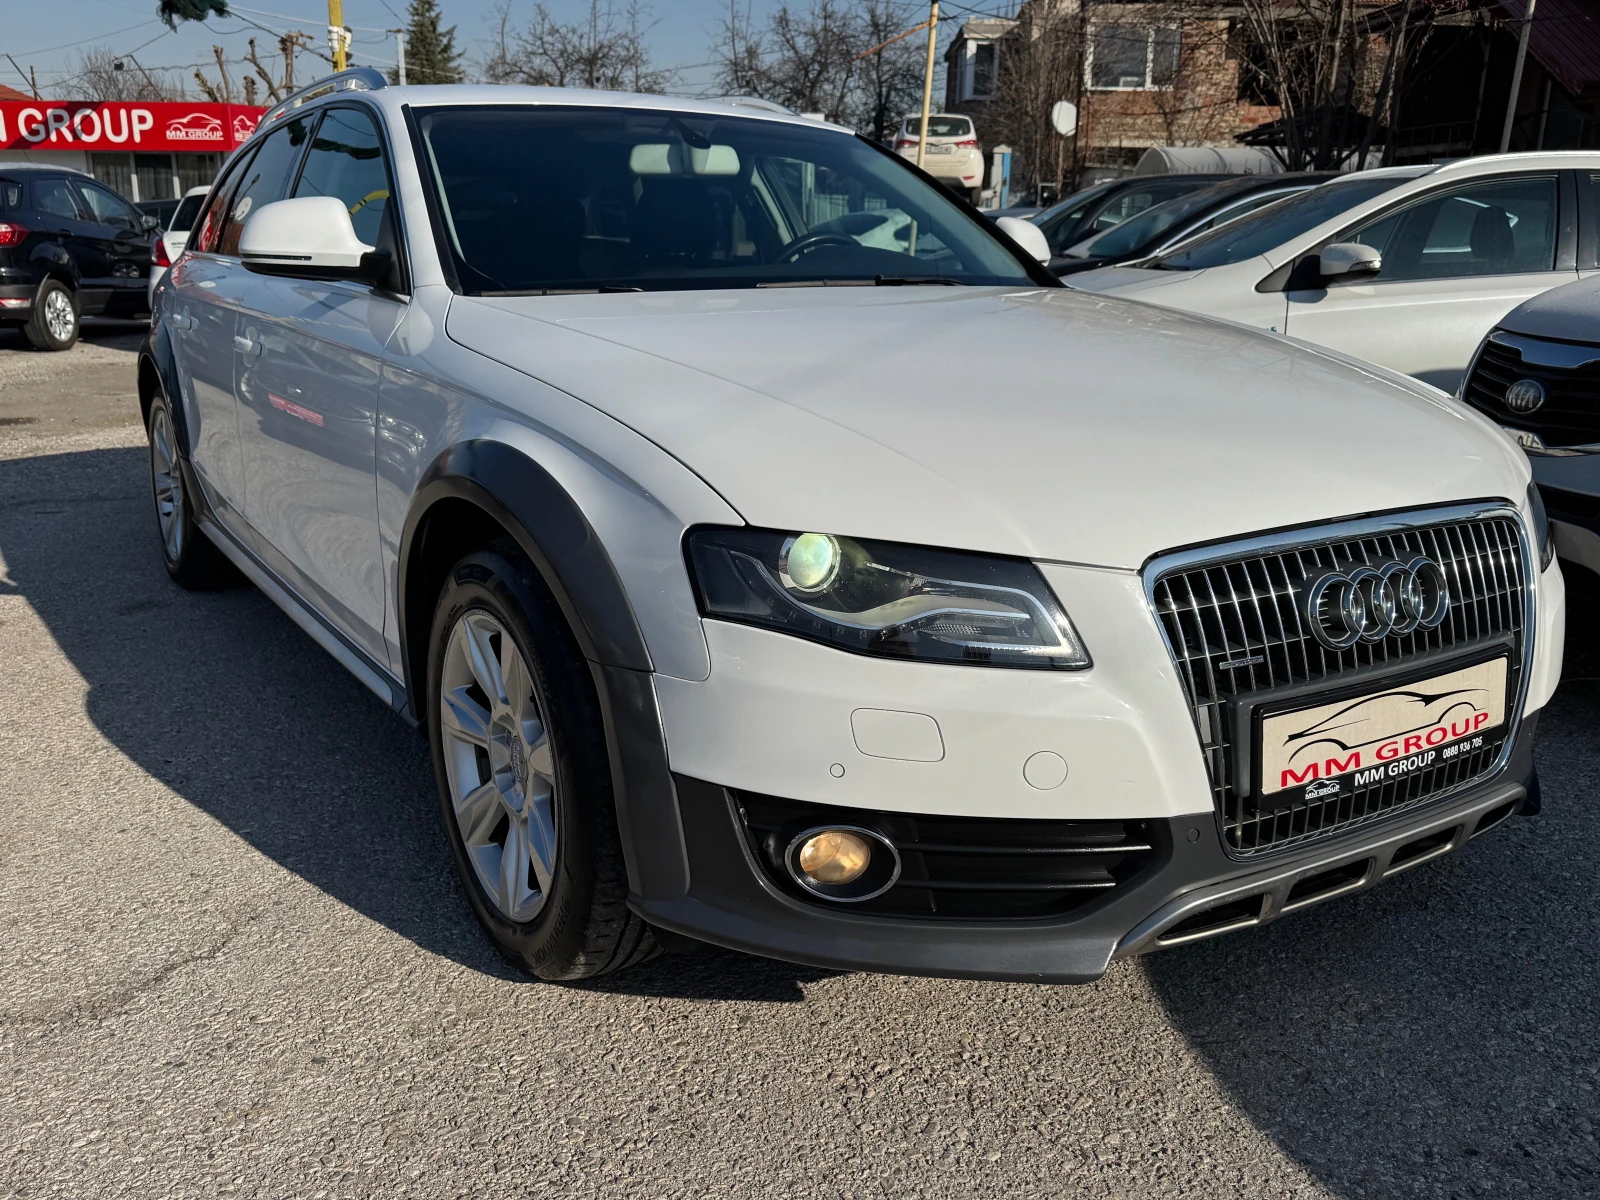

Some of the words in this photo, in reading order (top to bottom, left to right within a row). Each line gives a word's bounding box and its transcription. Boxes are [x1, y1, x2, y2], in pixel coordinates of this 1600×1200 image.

[18, 107, 154, 143] GROUP
[166, 130, 186, 138] MM
[188, 130, 223, 138] GROUP
[1281, 751, 1361, 787] MM
[1375, 712, 1489, 761] GROUP
[1354, 766, 1385, 787] MM
[1388, 750, 1436, 776] GROUP
[1442, 744, 1459, 759] 0888
[1459, 740, 1471, 753] 936
